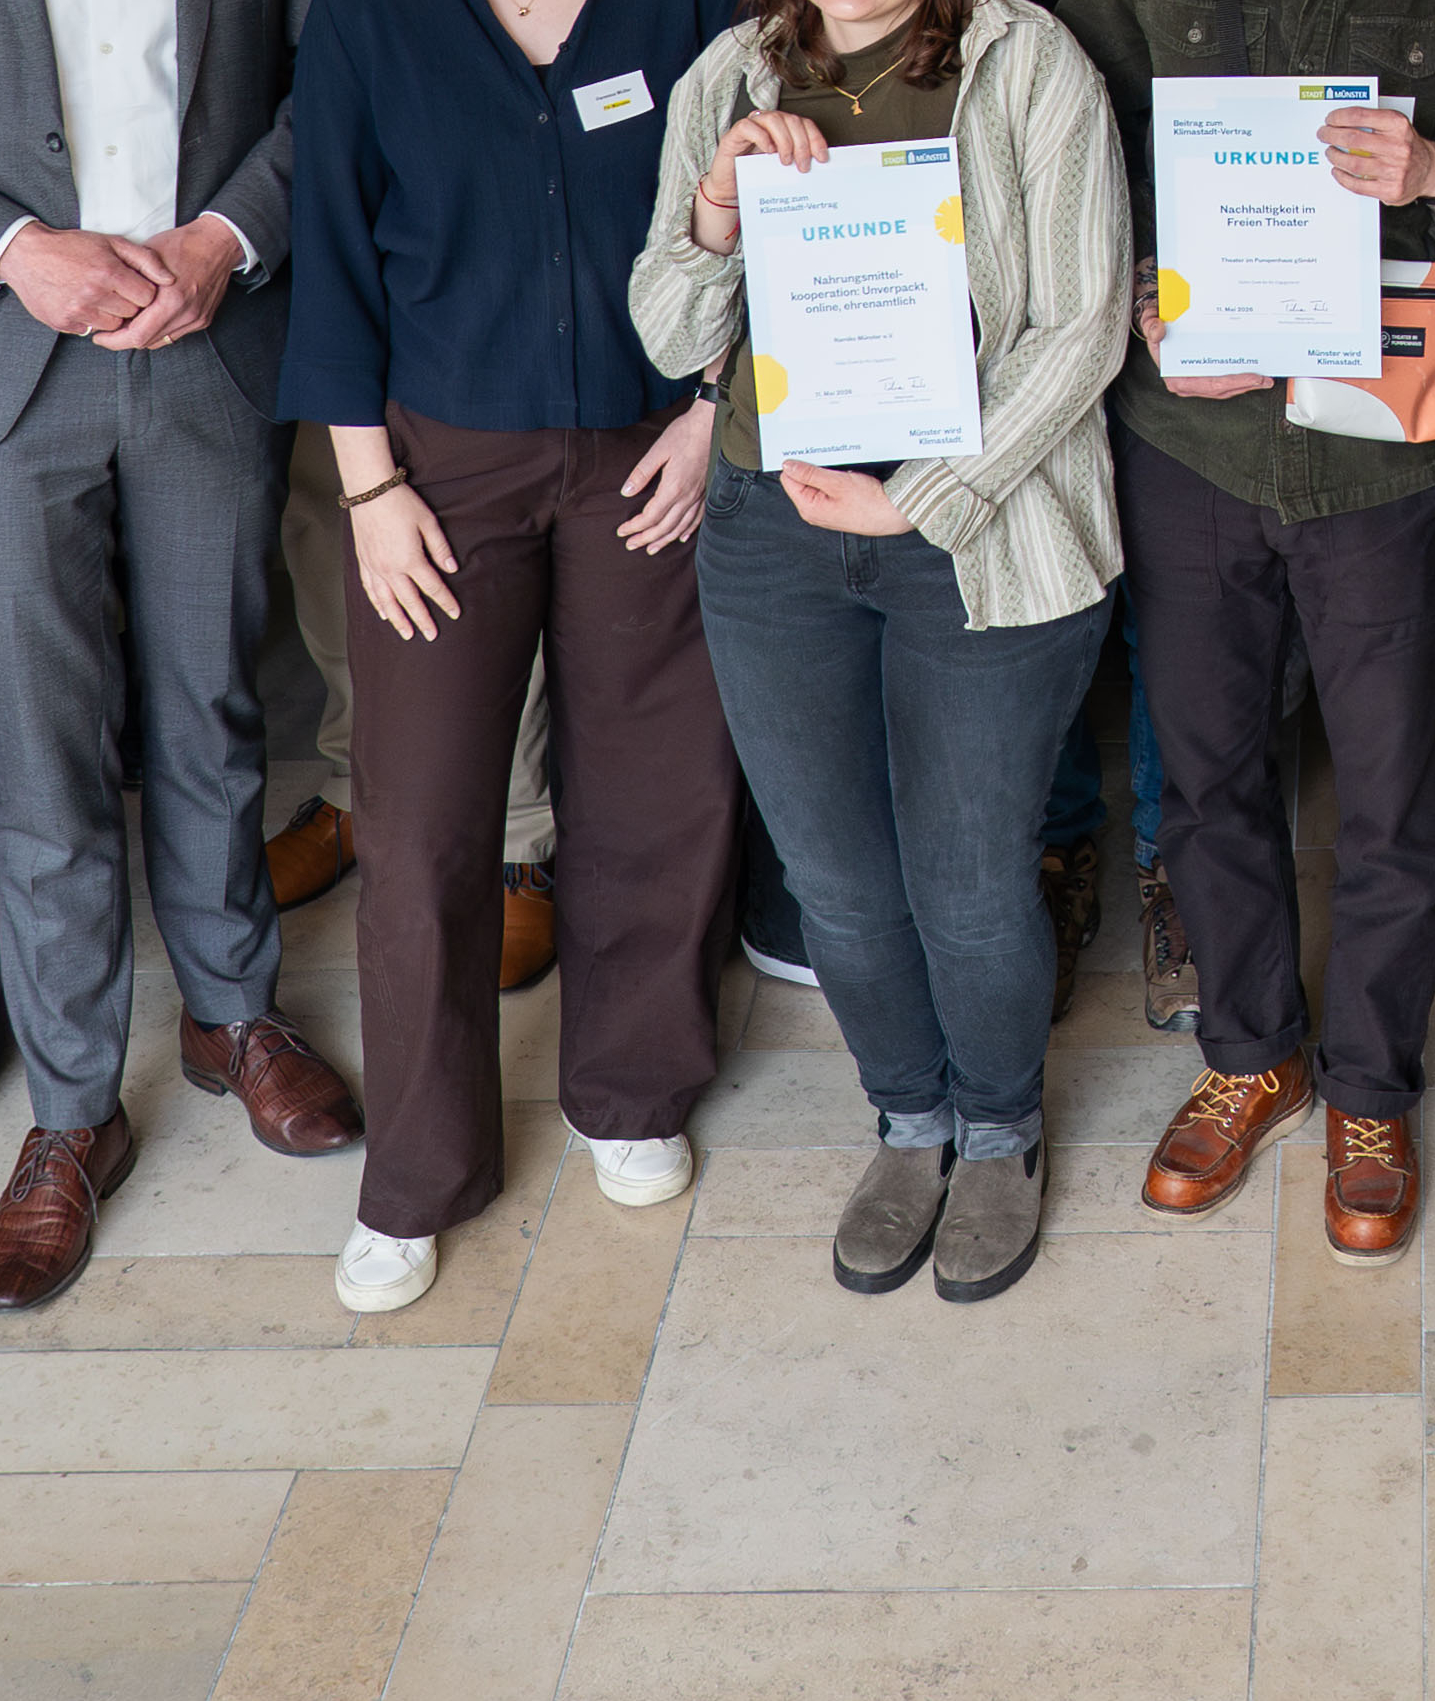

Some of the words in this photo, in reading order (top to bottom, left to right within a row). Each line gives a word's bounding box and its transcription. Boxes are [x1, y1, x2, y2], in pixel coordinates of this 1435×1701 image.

[1334, 89, 1367, 98] MÜNSTER
[1172, 119, 1203, 127] Beitrag
[1173, 127, 1252, 135] Klimastadt-Vertrag
[1214, 151, 1319, 165] URKUNDE
[758, 196, 790, 205] Beitrag
[759, 201, 838, 214] Klimastadt-Vertrag
[1219, 204, 1299, 215] Nachhaltigkeit
[1301, 206, 1315, 214] im
[1226, 217, 1262, 226] Freien
[1264, 217, 1308, 226] Theater
[801, 218, 906, 241] URKUNDE
[812, 269, 902, 285] Nahrungsmittel-
[790, 287, 860, 302] kooperation:
[861, 281, 927, 295] Unverpackt,
[804, 302, 841, 314] online,
[843, 295, 916, 310] ehrenamtlich
[908, 428, 941, 436] Münster
[943, 426, 961, 434] wird
[782, 444, 861, 456] www.klimastadt.ms
